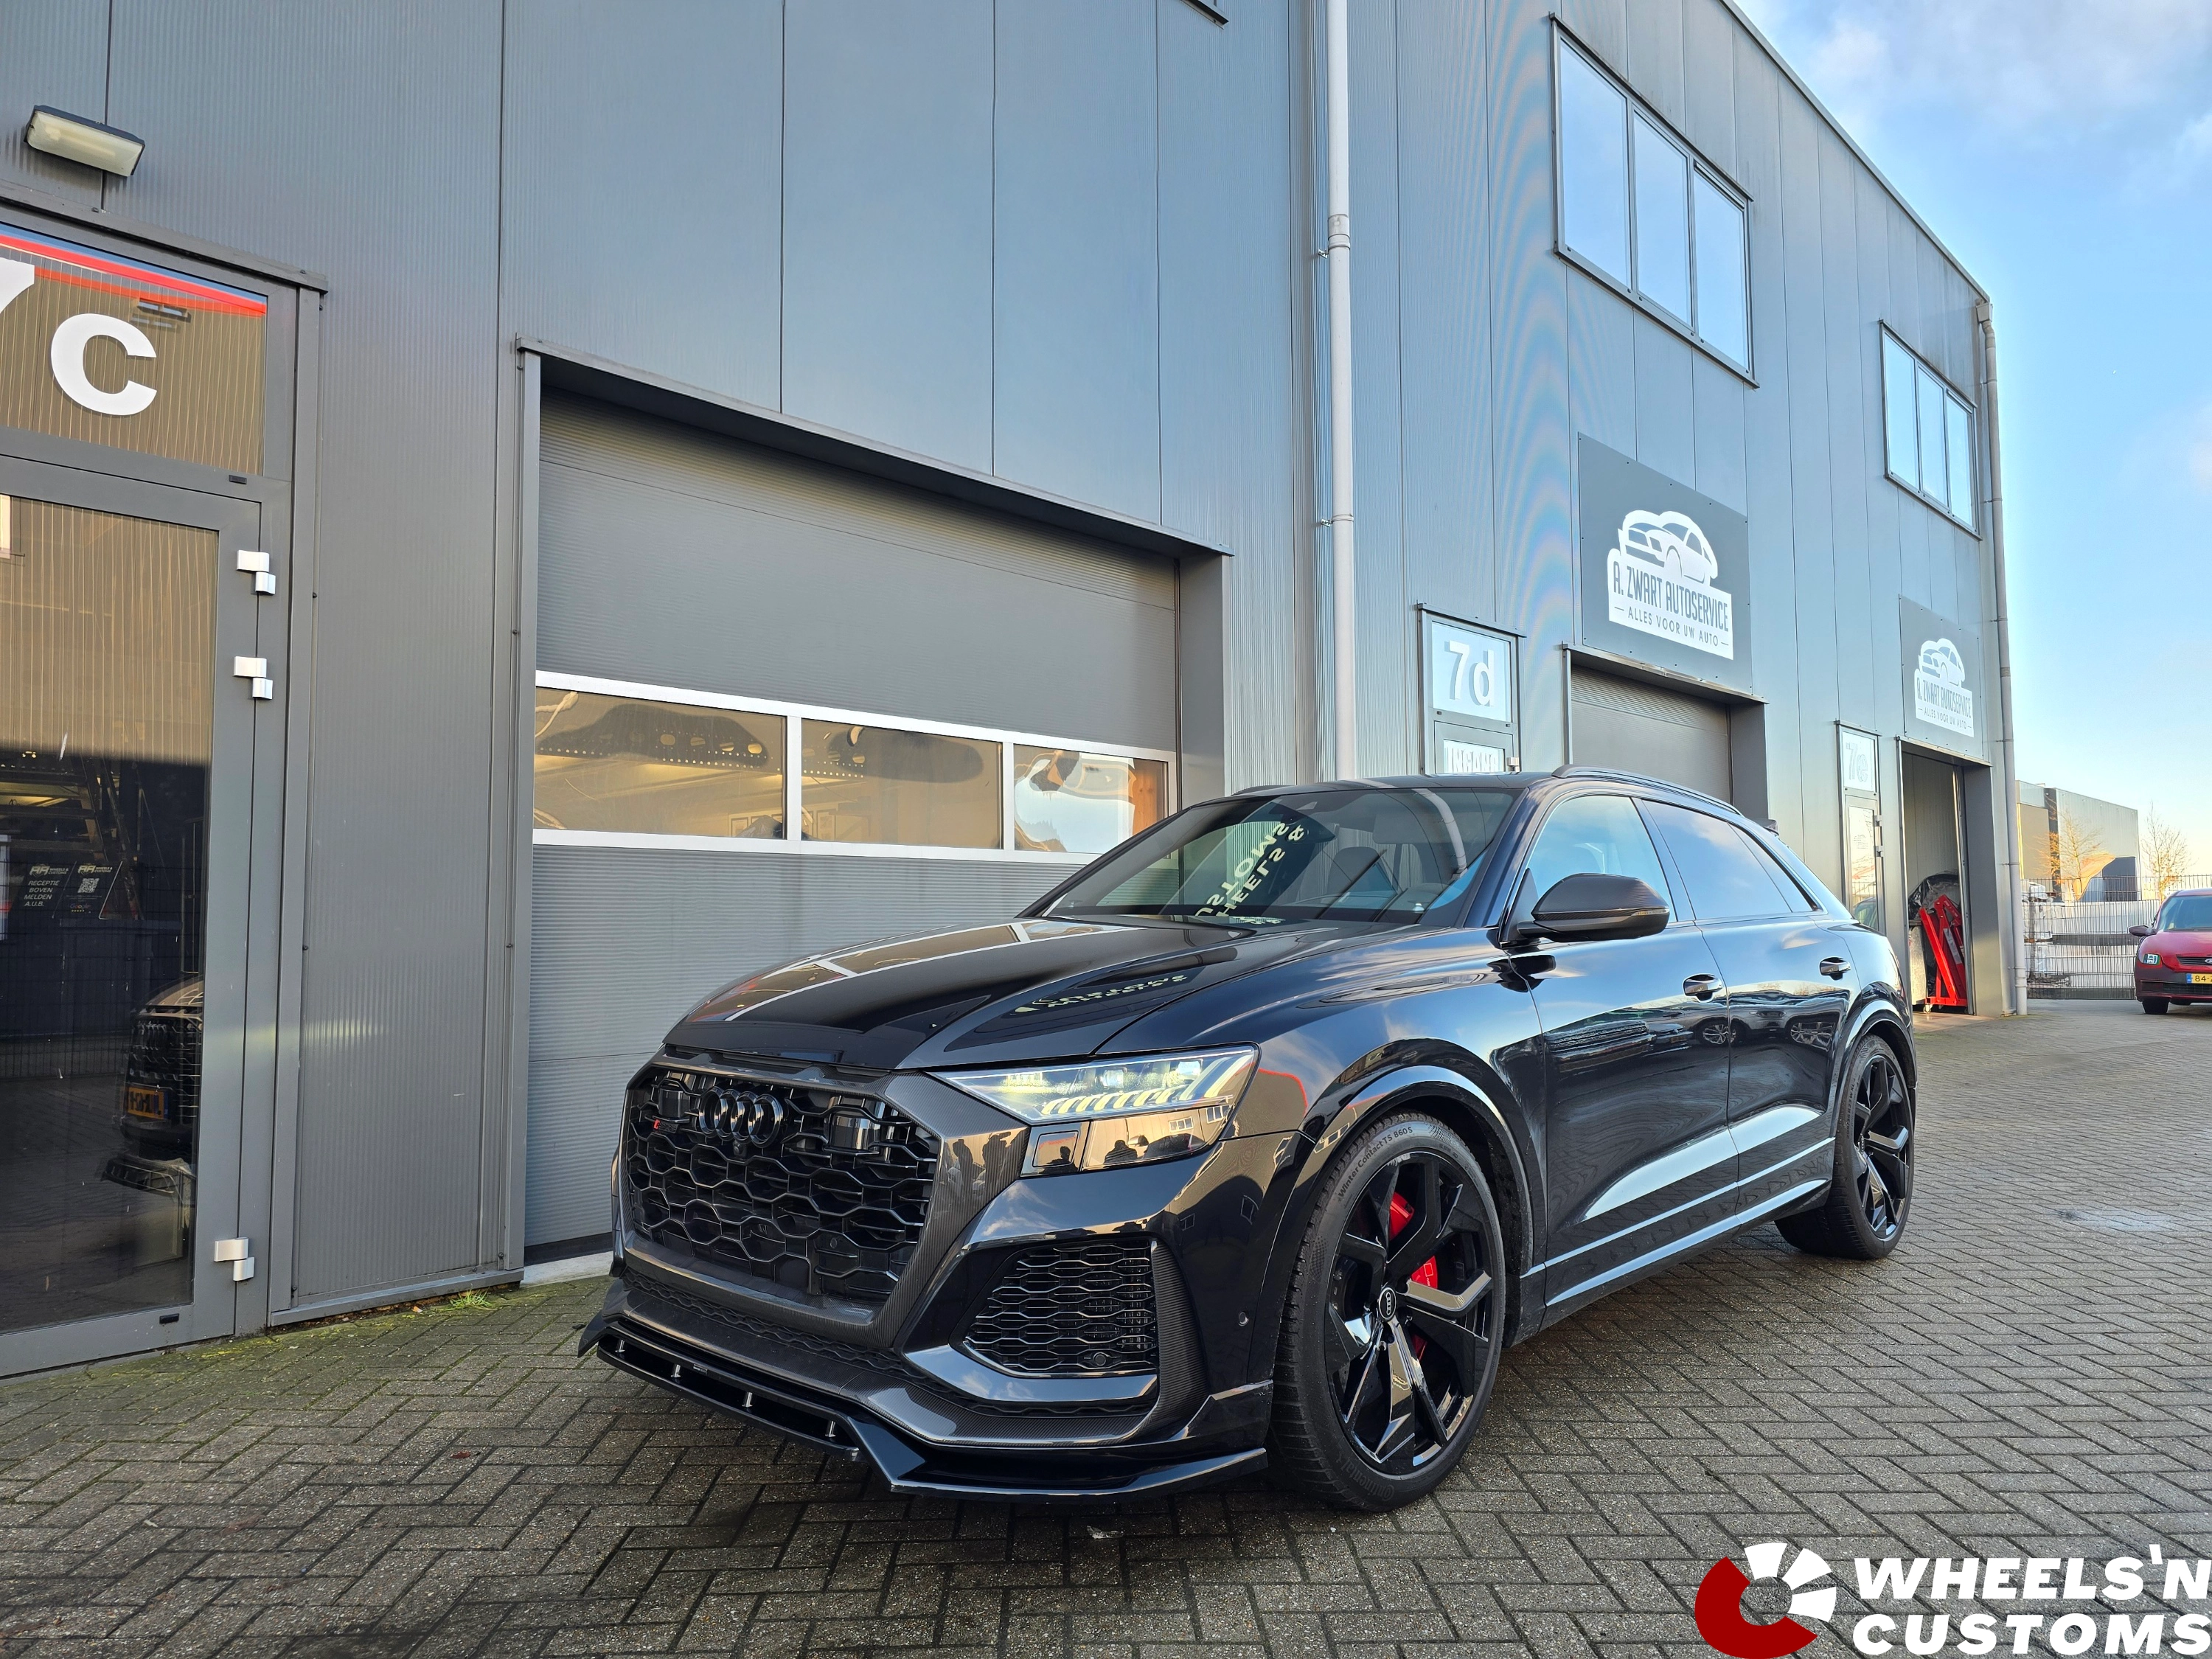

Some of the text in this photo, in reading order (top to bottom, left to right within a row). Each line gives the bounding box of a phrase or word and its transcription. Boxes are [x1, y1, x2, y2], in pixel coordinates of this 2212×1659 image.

[1613, 560, 1729, 632] A. ZWART AUTOSERVICE
[1628, 606, 1719, 647] ALLES VOOR UW AUTO
[1449, 639, 1495, 707] 7d
[1923, 679, 1940, 707] ZWART
[1941, 686, 1972, 719] AUTOSERVICE
[1924, 707, 1935, 719] ALLES
[1382, 1134, 1393, 1144] TS
[1394, 1128, 1408, 1138] 860
